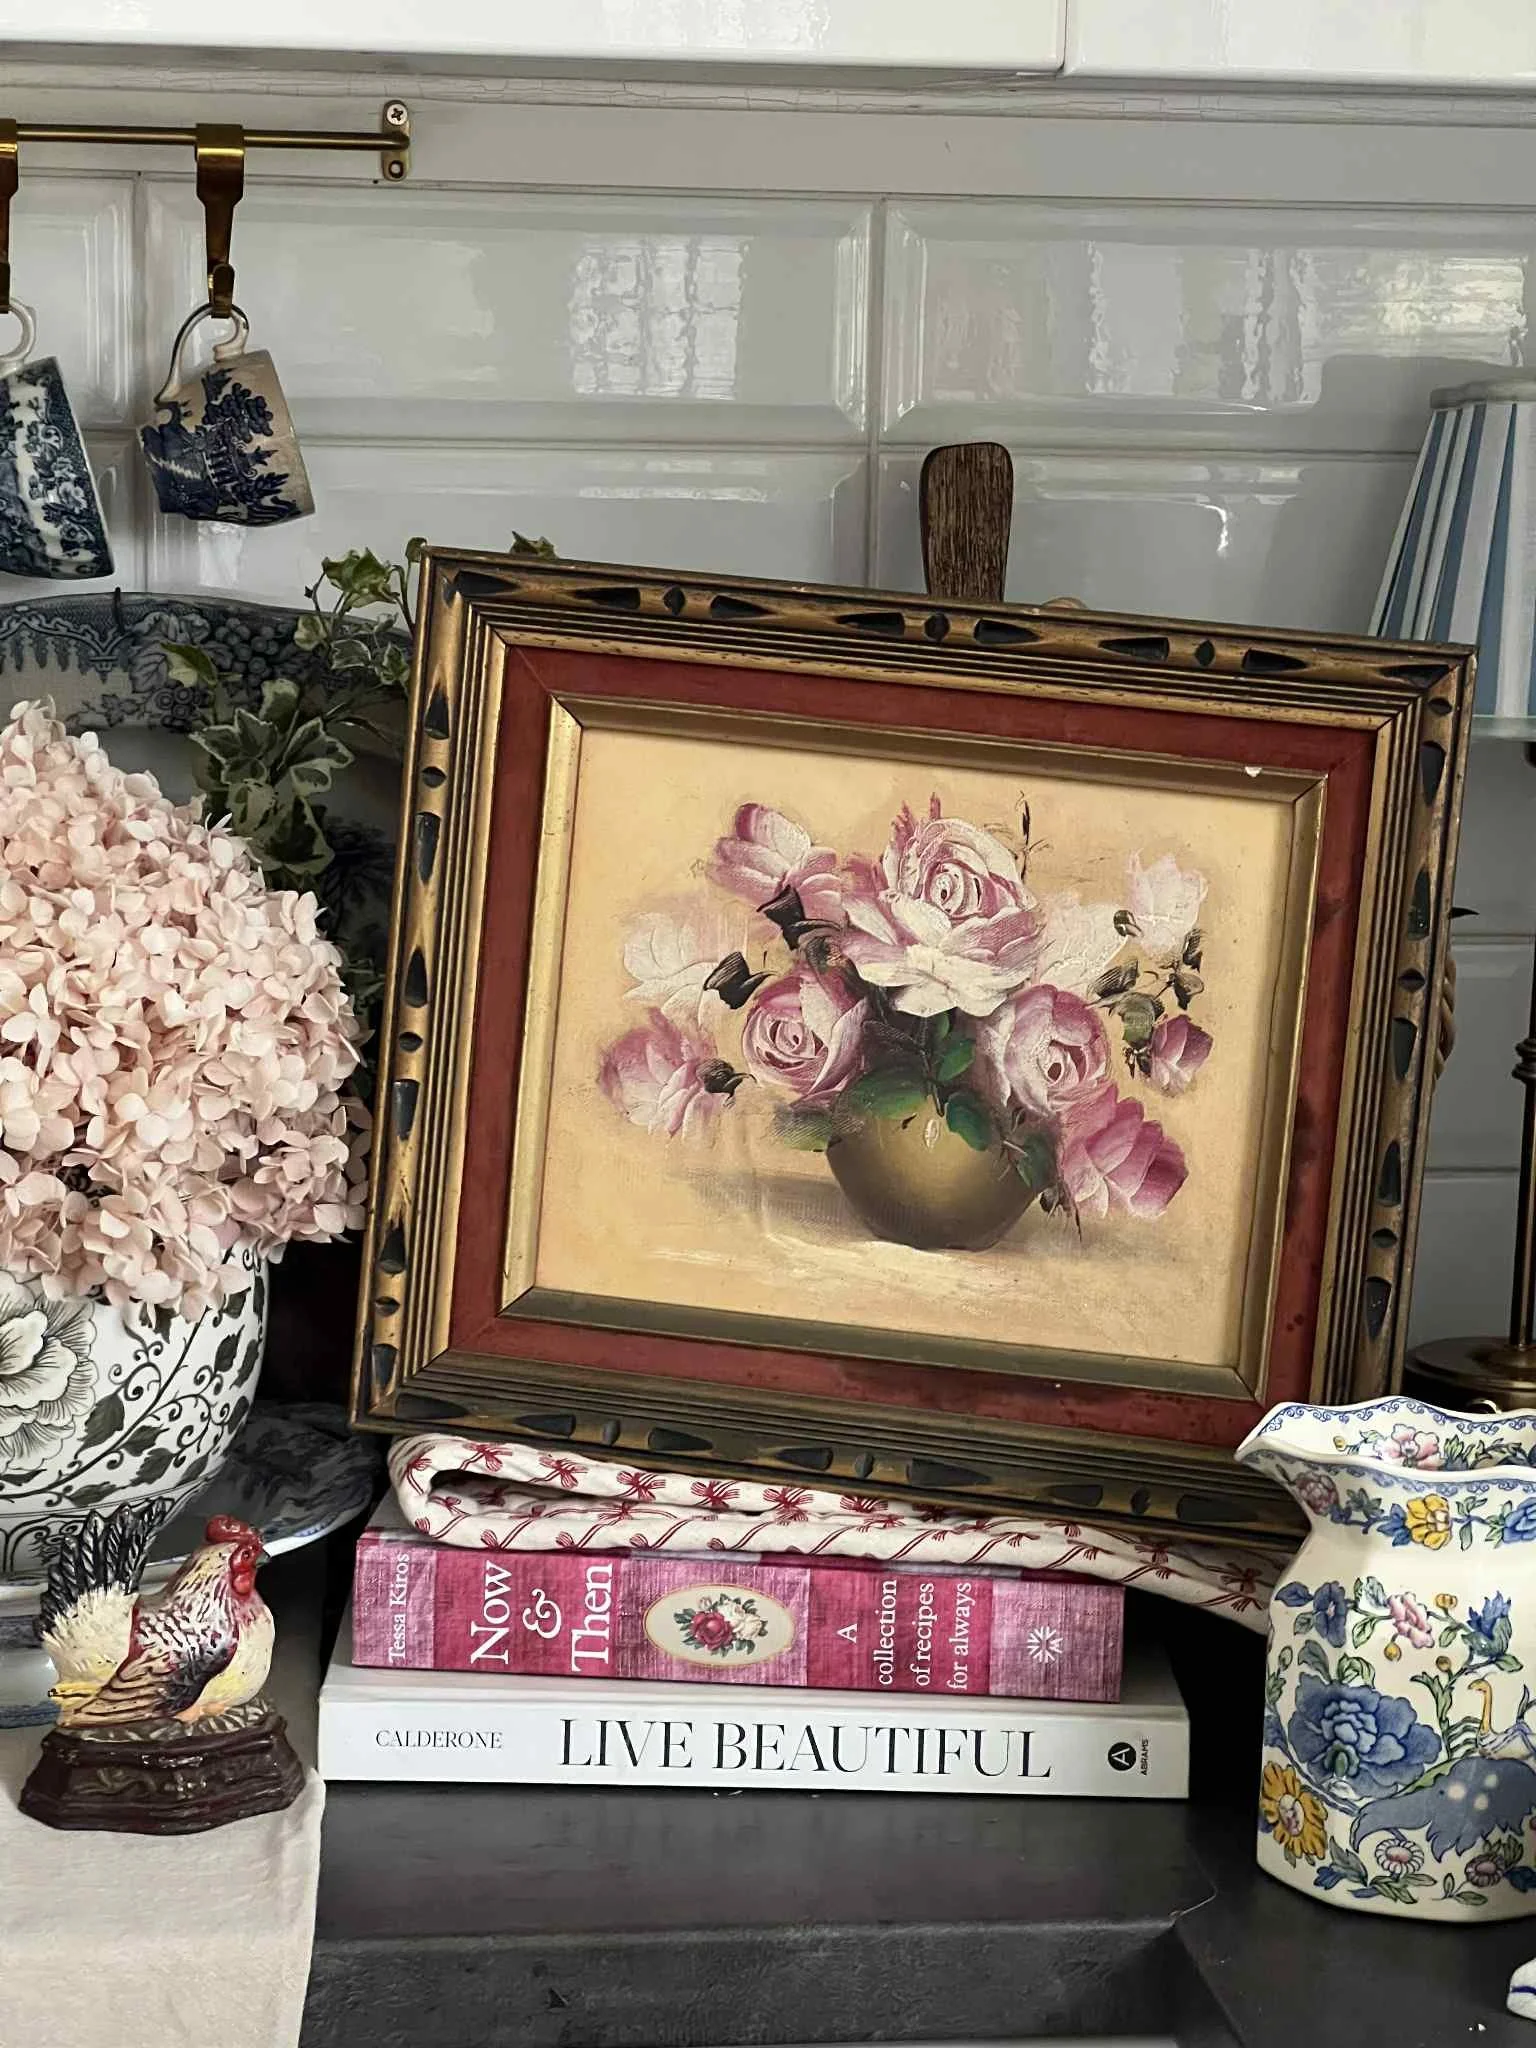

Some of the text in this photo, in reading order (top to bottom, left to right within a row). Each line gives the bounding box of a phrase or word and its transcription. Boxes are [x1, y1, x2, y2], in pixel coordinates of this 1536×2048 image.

[388, 1553, 409, 1663] Tessa Kiros
[470, 1560, 512, 1665] Now
[522, 1588, 562, 1639] &
[571, 1563, 614, 1672] Then
[836, 1623, 858, 1643] A
[873, 1579, 898, 1685] collection
[912, 1582, 937, 1686] of recipes
[947, 1582, 977, 1690] for always
[375, 1729, 503, 1750] CALDERONE
[560, 1718, 1051, 1779] LIVE BEAUTIFUL
[1140, 1738, 1149, 1776] ABRAMS
